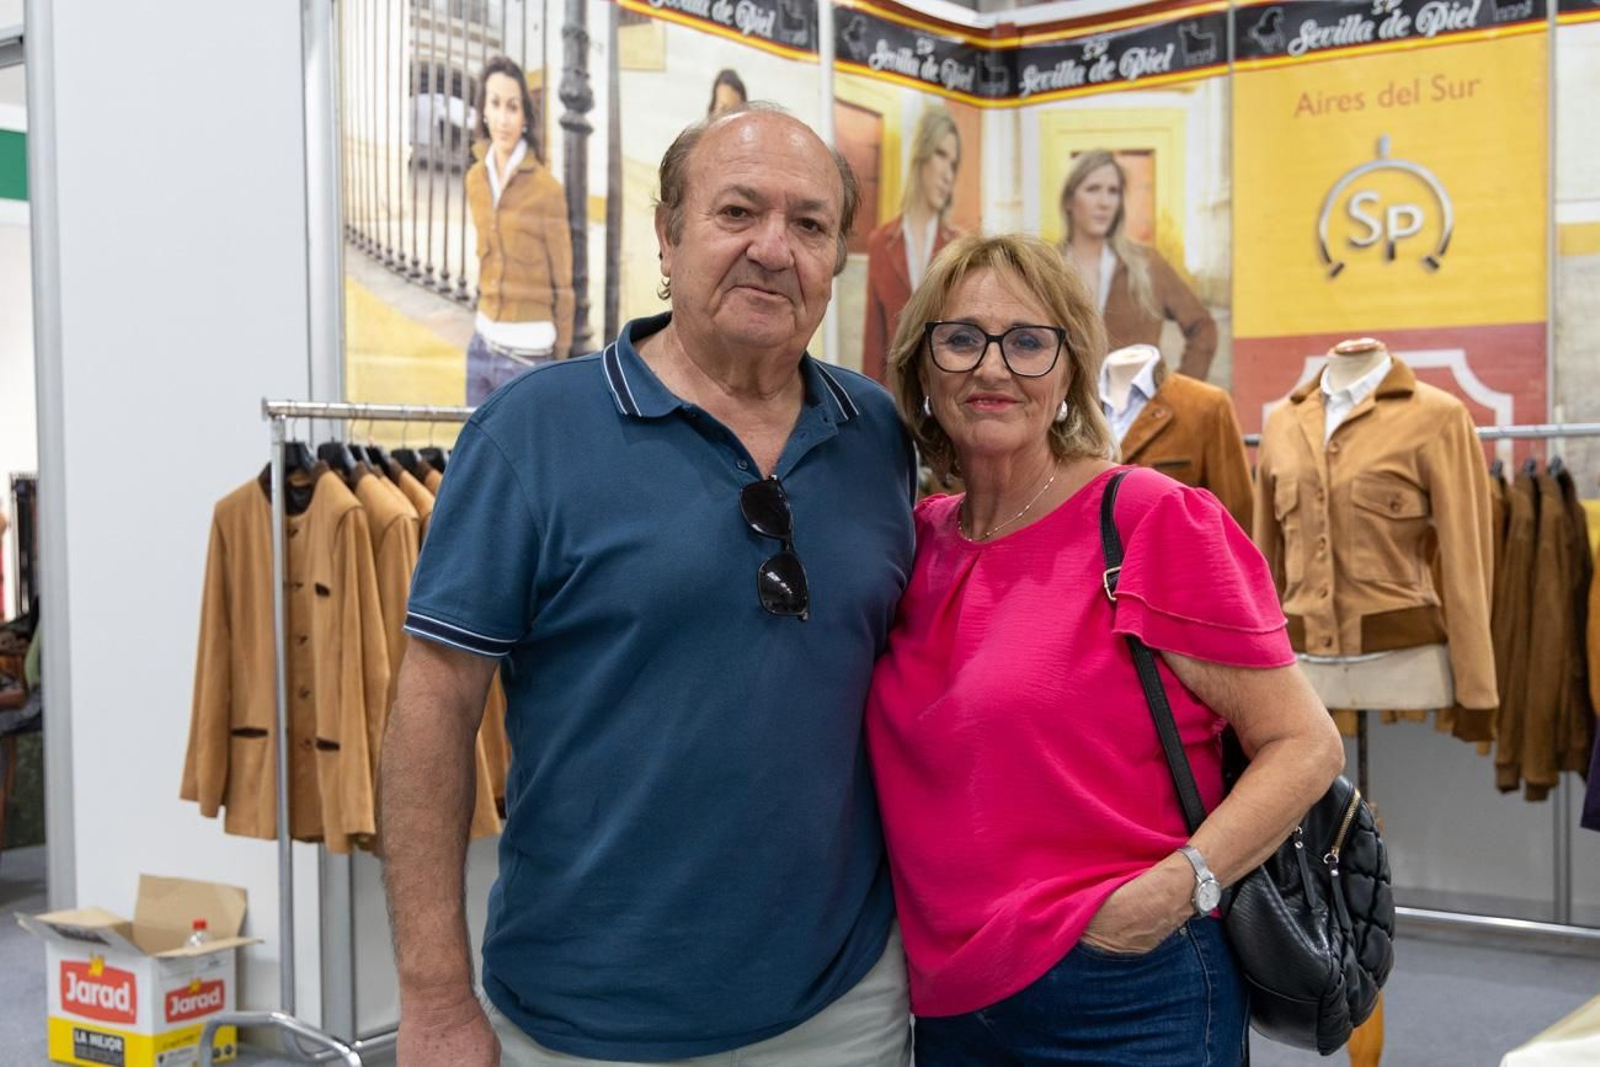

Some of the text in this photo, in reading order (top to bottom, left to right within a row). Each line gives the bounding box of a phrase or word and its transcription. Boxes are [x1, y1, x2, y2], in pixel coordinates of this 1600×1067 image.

[1287, 0, 1482, 57] Sevilla de Piel
[868, 38, 921, 76] Sevilla
[921, 54, 939, 82] de
[1018, 43, 1175, 98] Sevilla de Piel
[1293, 74, 1481, 118] Aires del Sur
[66, 971, 130, 1012] Jarad
[170, 985, 220, 1016] Jarad
[75, 1029, 88, 1044] LA
